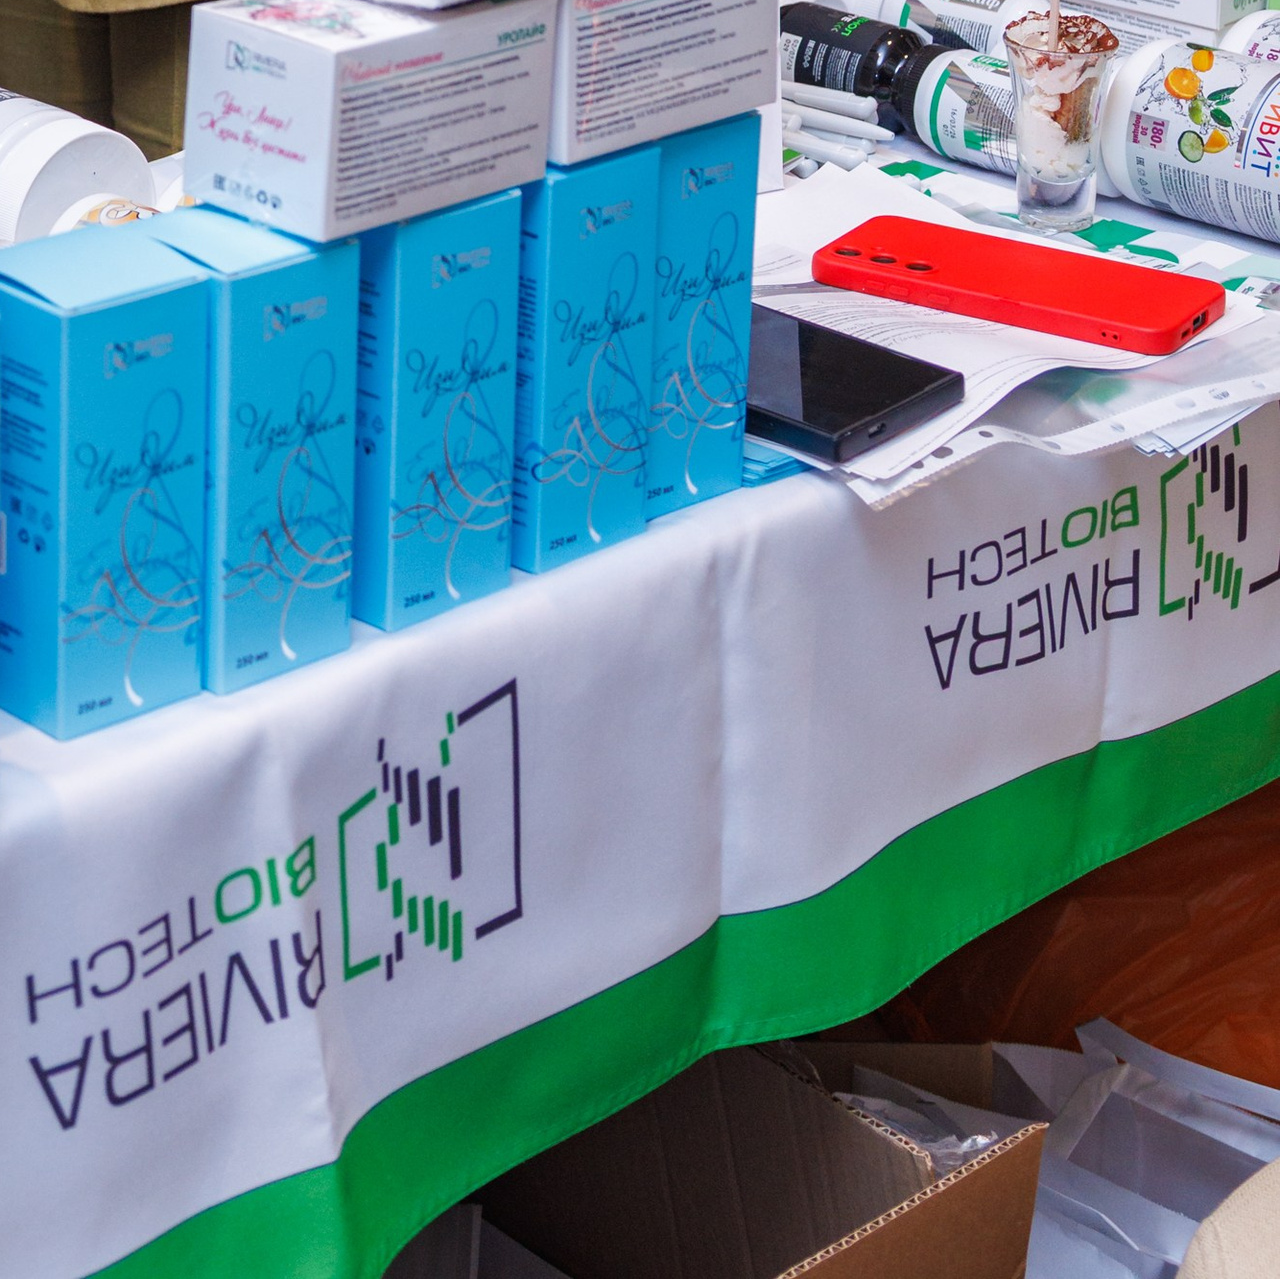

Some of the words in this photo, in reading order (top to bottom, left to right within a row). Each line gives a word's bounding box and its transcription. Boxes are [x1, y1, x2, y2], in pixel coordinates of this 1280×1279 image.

[924, 548, 1141, 691] RIVIERA
[927, 485, 1140, 600] BIOTECH
[24, 835, 317, 1026] BIOTECH
[28, 909, 327, 1132] RIVIERA
